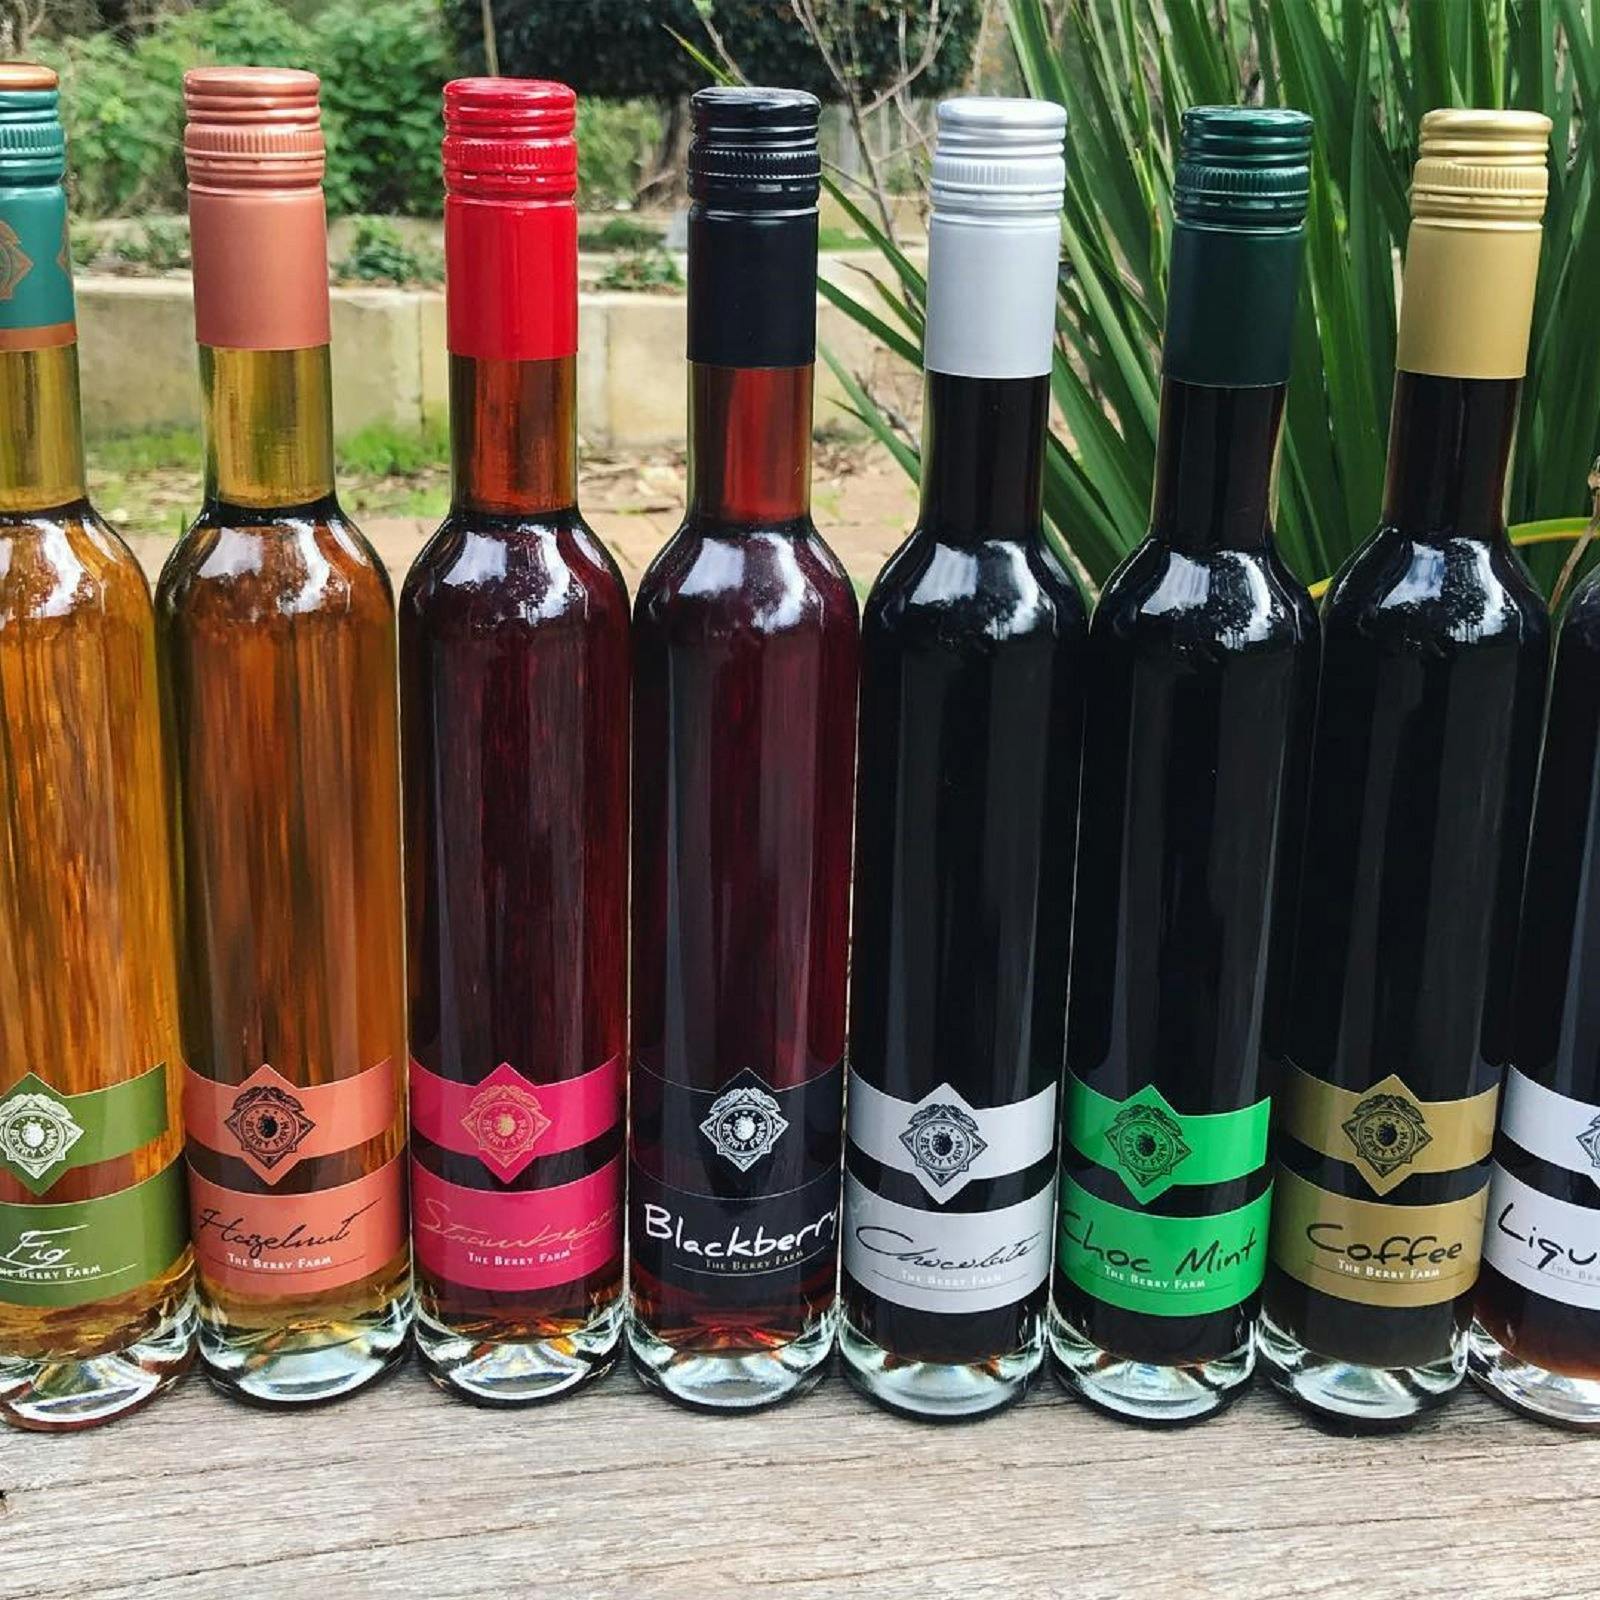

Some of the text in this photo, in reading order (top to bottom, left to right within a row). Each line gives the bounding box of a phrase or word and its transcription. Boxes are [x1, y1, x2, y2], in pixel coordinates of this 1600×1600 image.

[0, 1223, 90, 1273] Fig
[200, 1196, 383, 1259] Hazelnut
[644, 1202, 839, 1257] Blackberry
[856, 1225, 1043, 1270] Chocolate
[1062, 1209, 1257, 1276] Choc Mint
[1306, 1223, 1463, 1266] Coffee
[1497, 1202, 1598, 1271] Liqu
[66, 1264, 102, 1278] FARM
[227, 1252, 333, 1270] THE BERRY FARM
[467, 1249, 572, 1266] THE BERRY FARM
[705, 1251, 803, 1271] THE BERRY FARM
[1104, 1264, 1206, 1290] THE BERRY FARM
[1338, 1259, 1440, 1280] THE BERRY FARM
